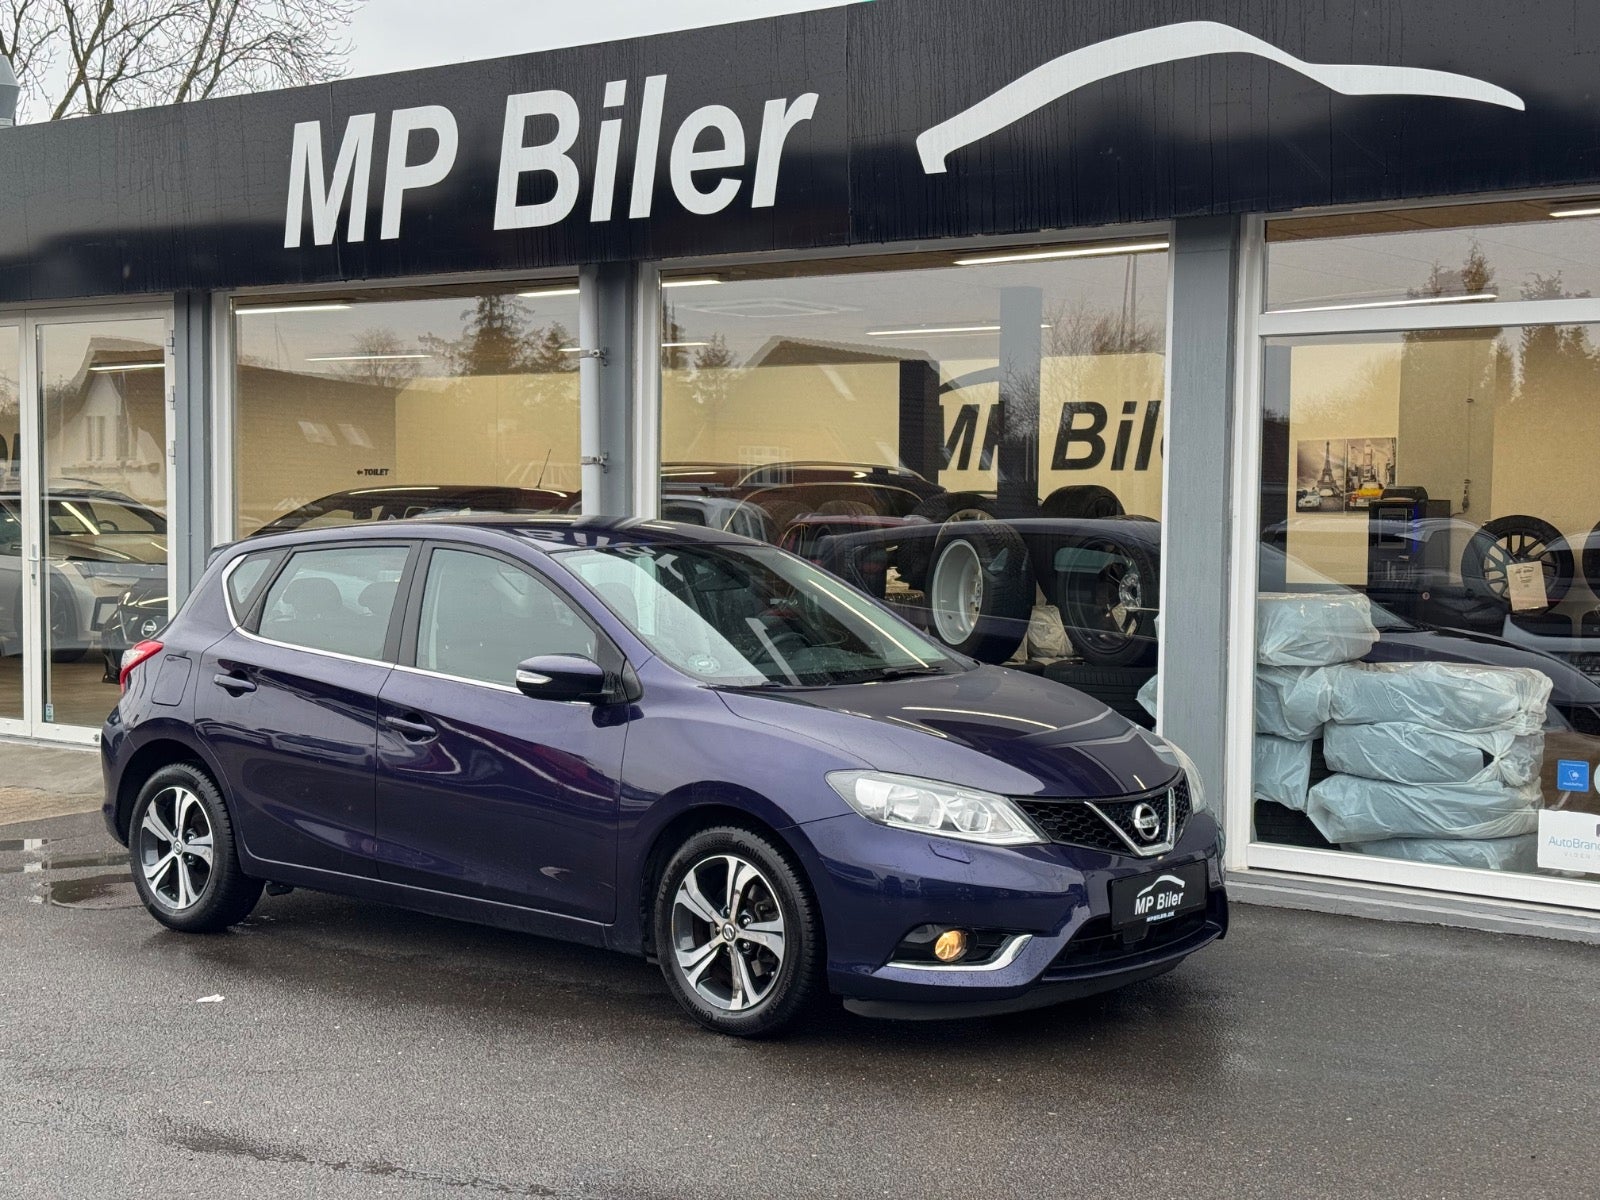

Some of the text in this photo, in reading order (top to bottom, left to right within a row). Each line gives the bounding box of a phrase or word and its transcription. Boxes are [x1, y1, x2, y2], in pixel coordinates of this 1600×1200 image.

[284, 74, 819, 248] MP Biler
[1050, 400, 1164, 471] Bil
[363, 468, 390, 476] TOILET
[1134, 890, 1184, 915] MP Biler
